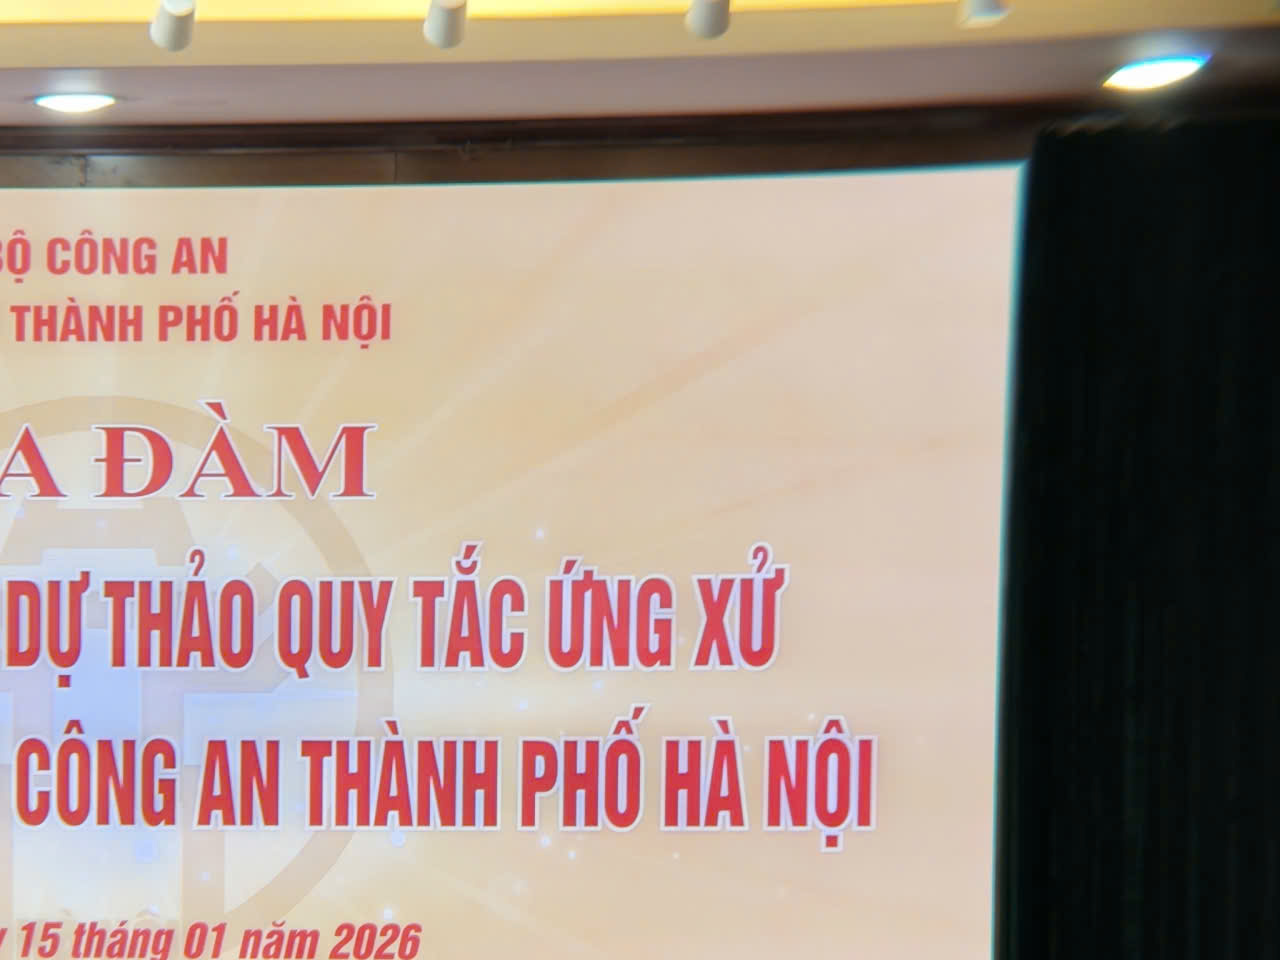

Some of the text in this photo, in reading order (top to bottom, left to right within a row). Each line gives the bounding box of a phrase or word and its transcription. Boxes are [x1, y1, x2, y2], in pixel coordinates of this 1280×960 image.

[47, 229, 156, 276] CÔNG
[172, 236, 227, 275] AN
[10, 297, 143, 343] THÀNH
[158, 290, 240, 343] PHỐ
[253, 295, 307, 343] HÀ
[322, 294, 391, 350] NỘI
[92, 402, 377, 497] ĐÀM
[7, 571, 89, 688] DỰ
[103, 550, 255, 669] THẢO
[276, 580, 393, 679] QUY
[413, 545, 526, 668] TẮC
[549, 560, 674, 668] ỨNG
[693, 546, 786, 667] XỬ
[16, 719, 177, 827] CÔNG
[197, 740, 281, 827] AN
[300, 720, 499, 827] THÀNH
[520, 707, 644, 829] PHỐ
[664, 720, 745, 828] HÀ
[766, 719, 874, 849] NỘI
[18, 921, 63, 959] 15
[182, 921, 226, 960] 01
[237, 922, 321, 960] năm
